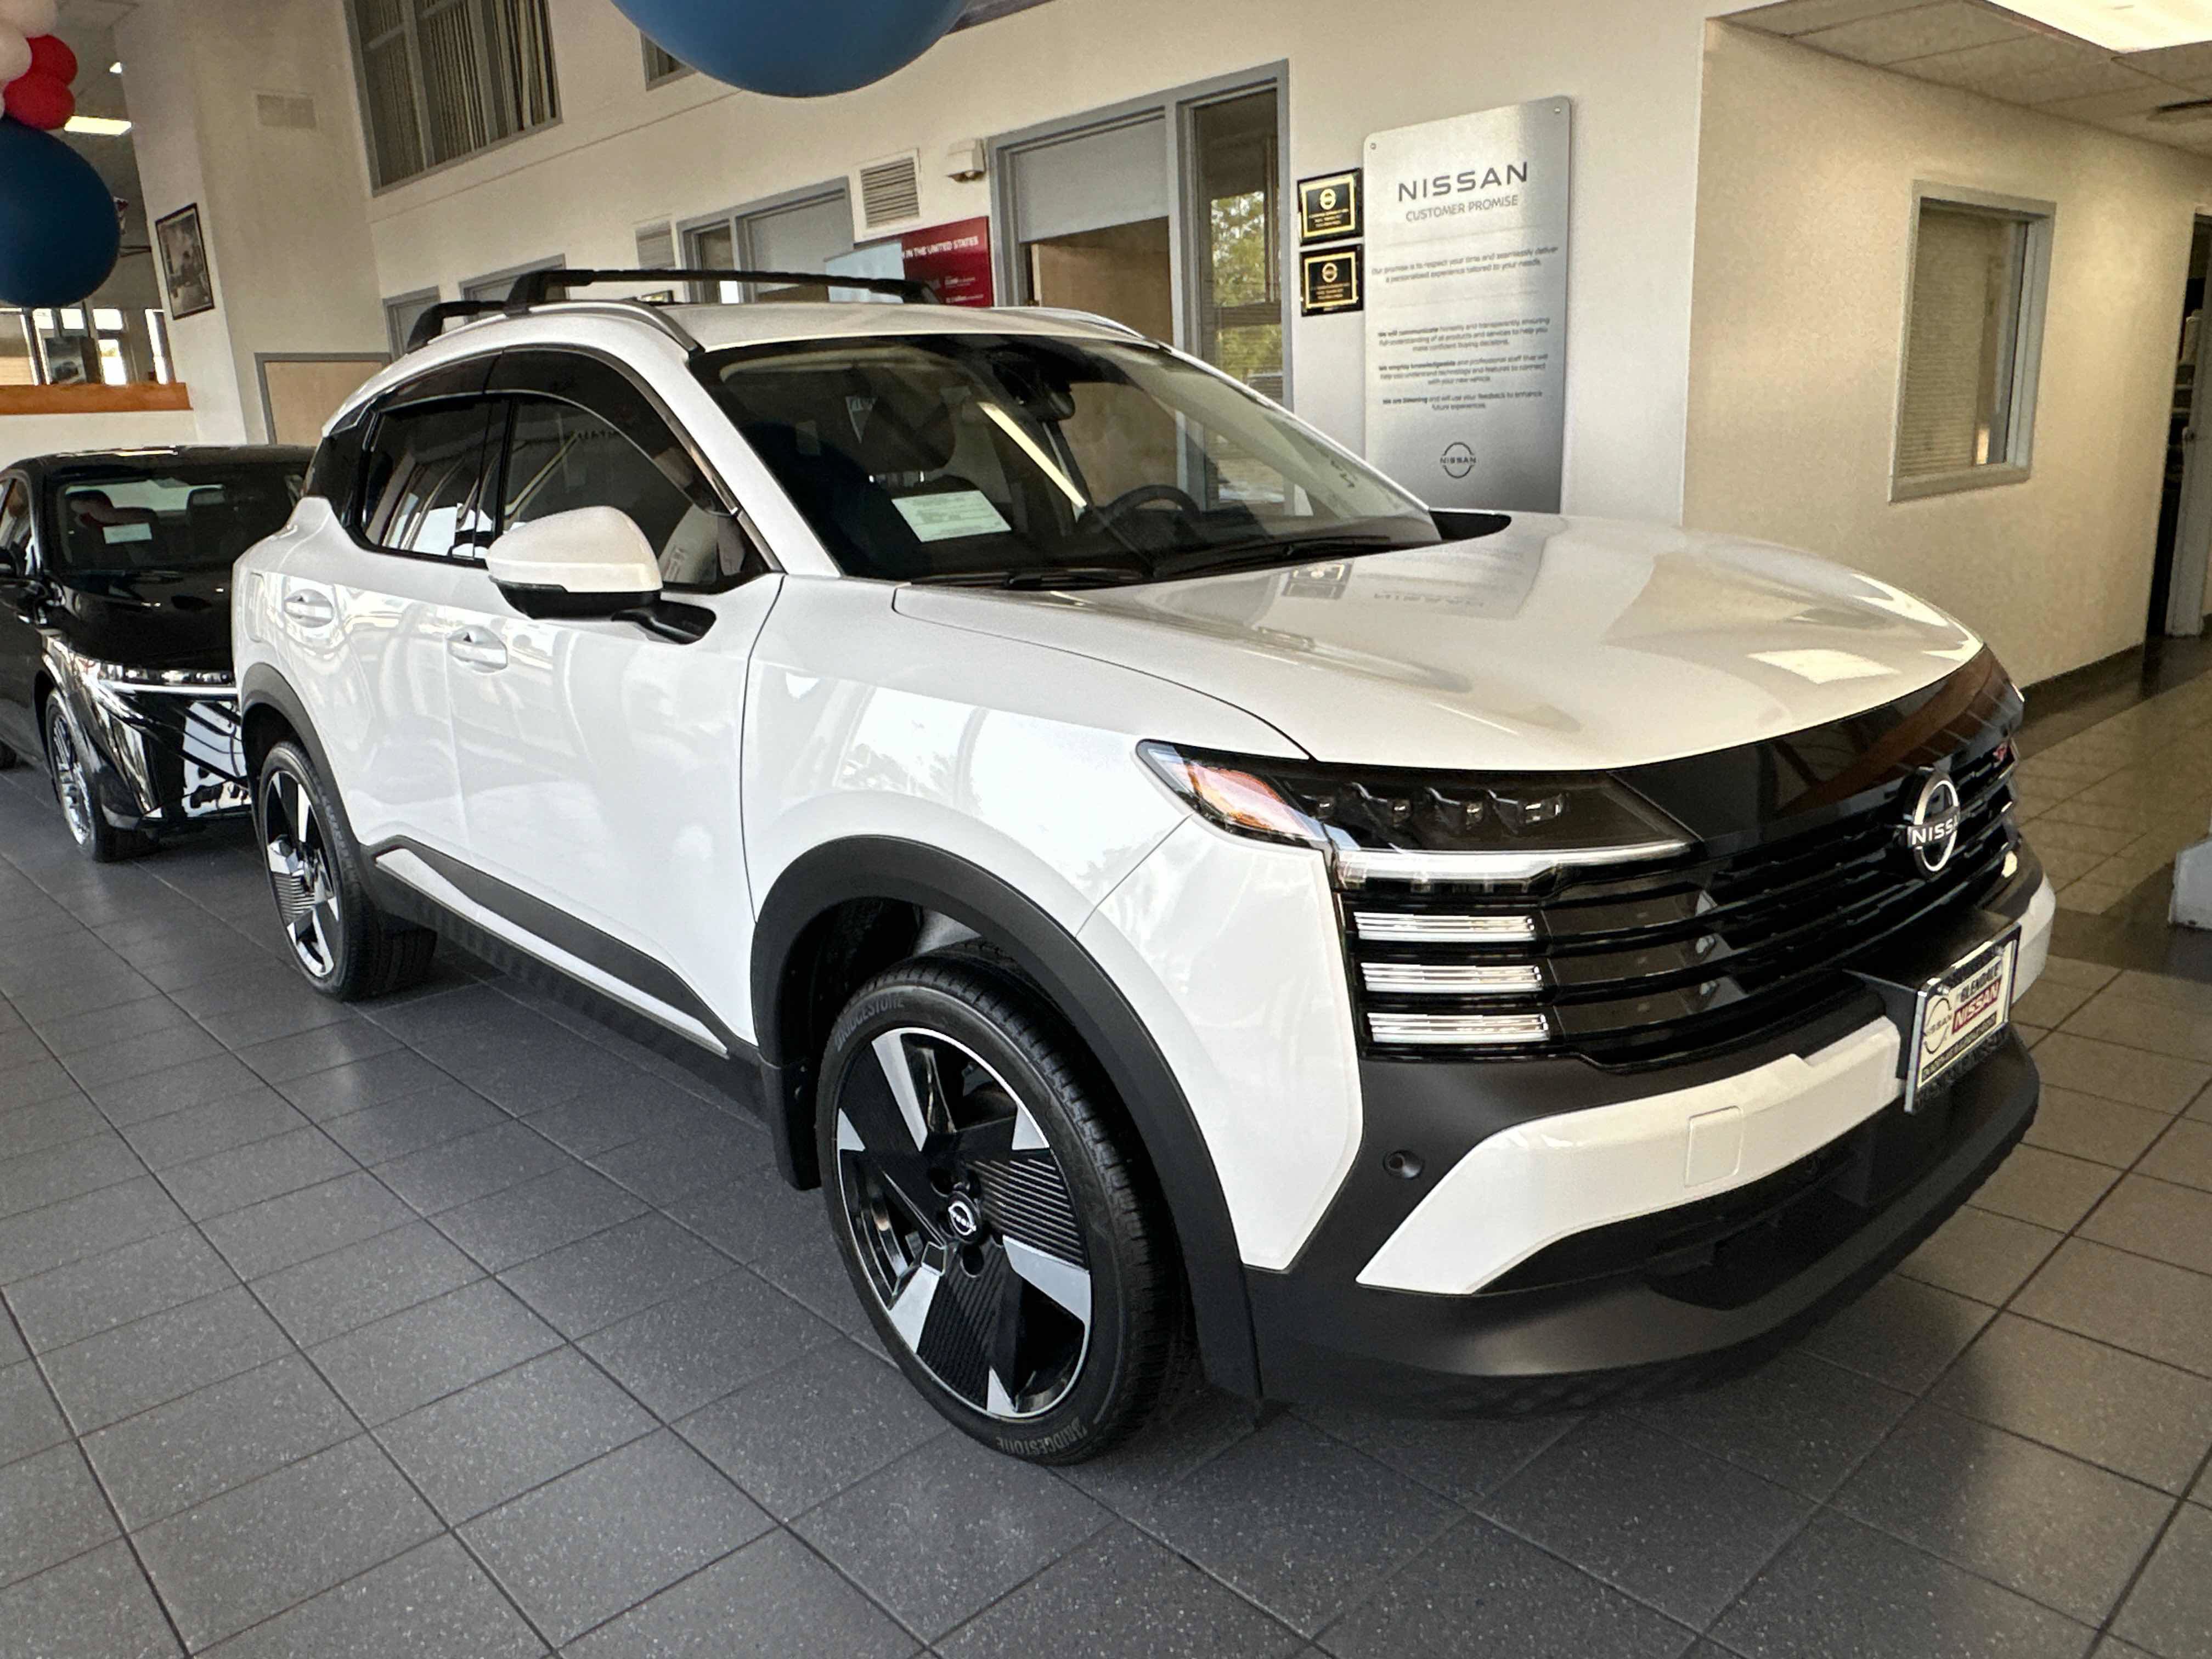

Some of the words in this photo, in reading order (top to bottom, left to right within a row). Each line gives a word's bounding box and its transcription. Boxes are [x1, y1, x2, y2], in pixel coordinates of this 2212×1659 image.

[1398, 161, 1528, 202] NISSAN
[1406, 202, 1466, 222] CUSTOMER
[1468, 195, 1519, 213] PROMISE
[914, 246, 927, 257] THE
[927, 241, 953, 255] UNITED
[953, 235, 979, 250] STATES
[1440, 456, 1476, 465] NISSAN
[1911, 814, 1958, 845] NISS
[1954, 980, 2000, 1030] NISSAN
